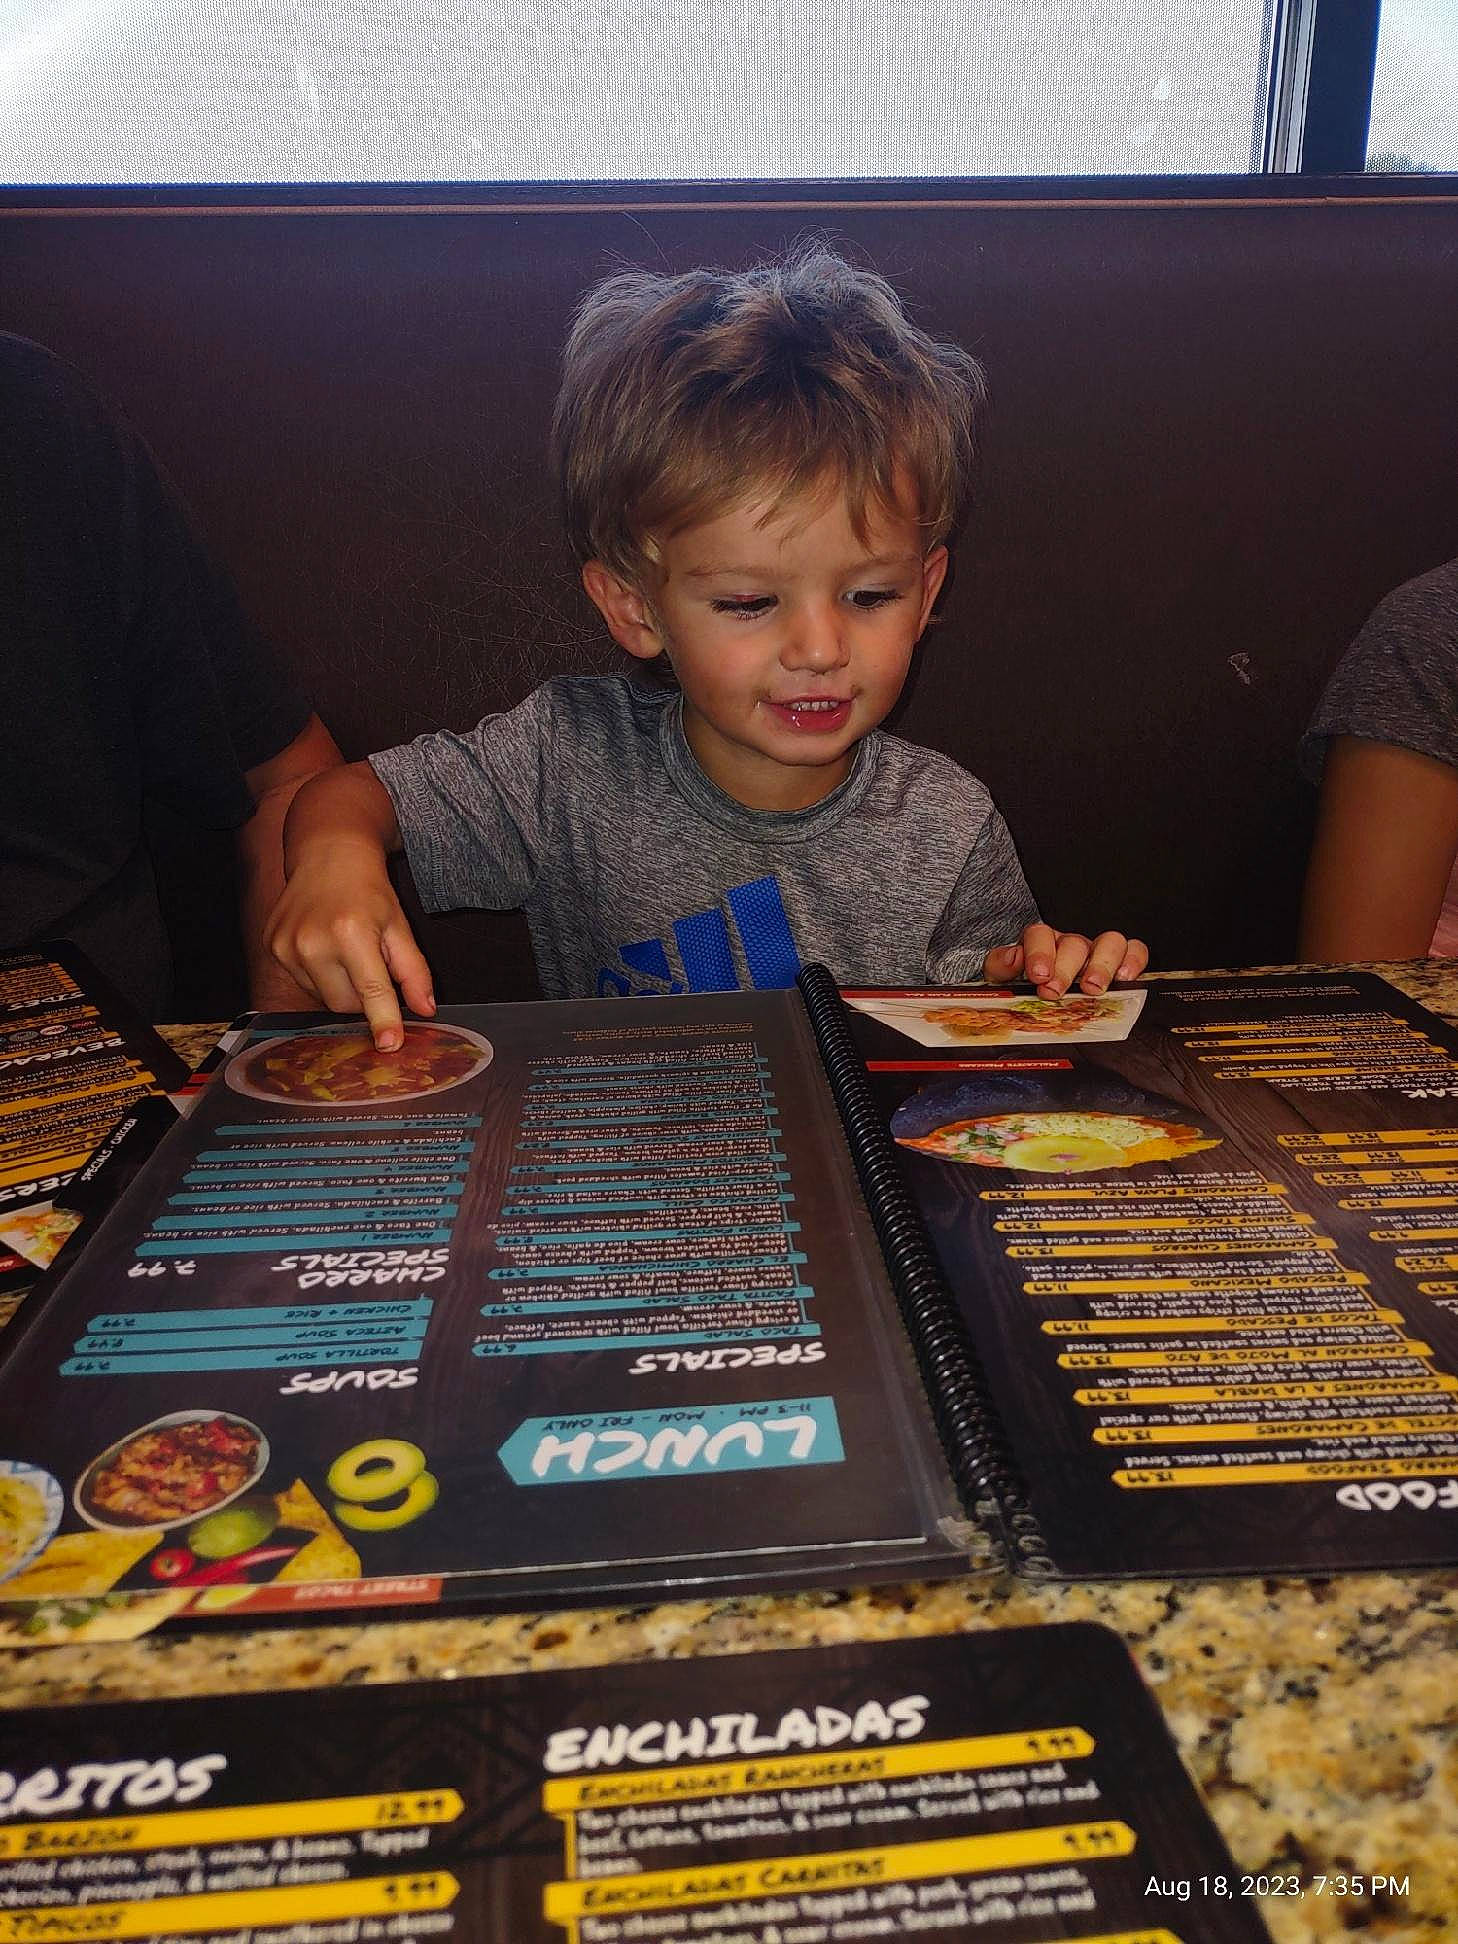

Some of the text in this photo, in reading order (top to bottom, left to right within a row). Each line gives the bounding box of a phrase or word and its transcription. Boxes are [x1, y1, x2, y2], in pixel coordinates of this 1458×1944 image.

[81, 1148, 113, 1182] SPECIALS
[334, 1199, 389, 1209] enchilada.
[191, 1205, 226, 1215] beans.
[221, 1228, 246, 1237] with
[248, 1226, 288, 1235] Served
[292, 1224, 349, 1234] enchilada.
[142, 1230, 179, 1240] beans.
[271, 1248, 449, 1271] SPECIALS
[297, 1266, 445, 1289] CHARRO
[1190, 1278, 1271, 1286] MEXICANO
[1278, 1275, 1346, 1283] PESCADO
[722, 1282, 748, 1290] flour
[750, 1279, 782, 1287] crispy
[624, 1288, 651, 1296] filled
[654, 1286, 677, 1294] bowl
[680, 1284, 719, 1292] tortilla
[518, 1292, 558, 1303] chicken
[560, 1291, 595, 1299] grilled
[598, 1288, 621, 1298] with
[504, 1294, 516, 1304] or
[284, 1309, 322, 1318] RICE
[343, 1305, 411, 1314] CHICKEN
[736, 1308, 783, 1317] shredded
[786, 1305, 798, 1315] or
[648, 1314, 685, 1323] Topped
[690, 1311, 733, 1320] chicken.
[755, 1315, 789, 1324] crispy
[1330, 1313, 1381, 1322] TACOS
[548, 1318, 580, 1329] sauce,
[584, 1318, 618, 1326] cheese
[681, 1321, 722, 1330] tortilla
[725, 1318, 752, 1327] flour
[1226, 1316, 1297, 1326] PESCADO
[345, 1326, 406, 1335] AZTECA
[504, 1323, 544, 1332] lettuce,
[595, 1327, 620, 1335] with
[622, 1325, 651, 1334] filled
[654, 1323, 679, 1332] bowl
[762, 1326, 802, 1337] TACO
[474, 1334, 500, 1342] beef
[502, 1331, 541, 1342] ground
[325, 1347, 398, 1357] TORTILLA
[481, 1343, 517, 1355] 6.99
[275, 1352, 317, 1360] SOUP
[628, 1341, 827, 1375] SPECIALS
[1164, 1353, 1200, 1361] AJO
[1235, 1350, 1289, 1359] MOJO
[278, 1368, 419, 1395] SOUPS
[738, 1404, 770, 1417] PM
[657, 1410, 705, 1424] MON
[540, 1418, 595, 1433] ONLY
[600, 1416, 634, 1428] FRI
[530, 1414, 818, 1478] LUNCH
[544, 1694, 931, 1774] ENCHILADAS
